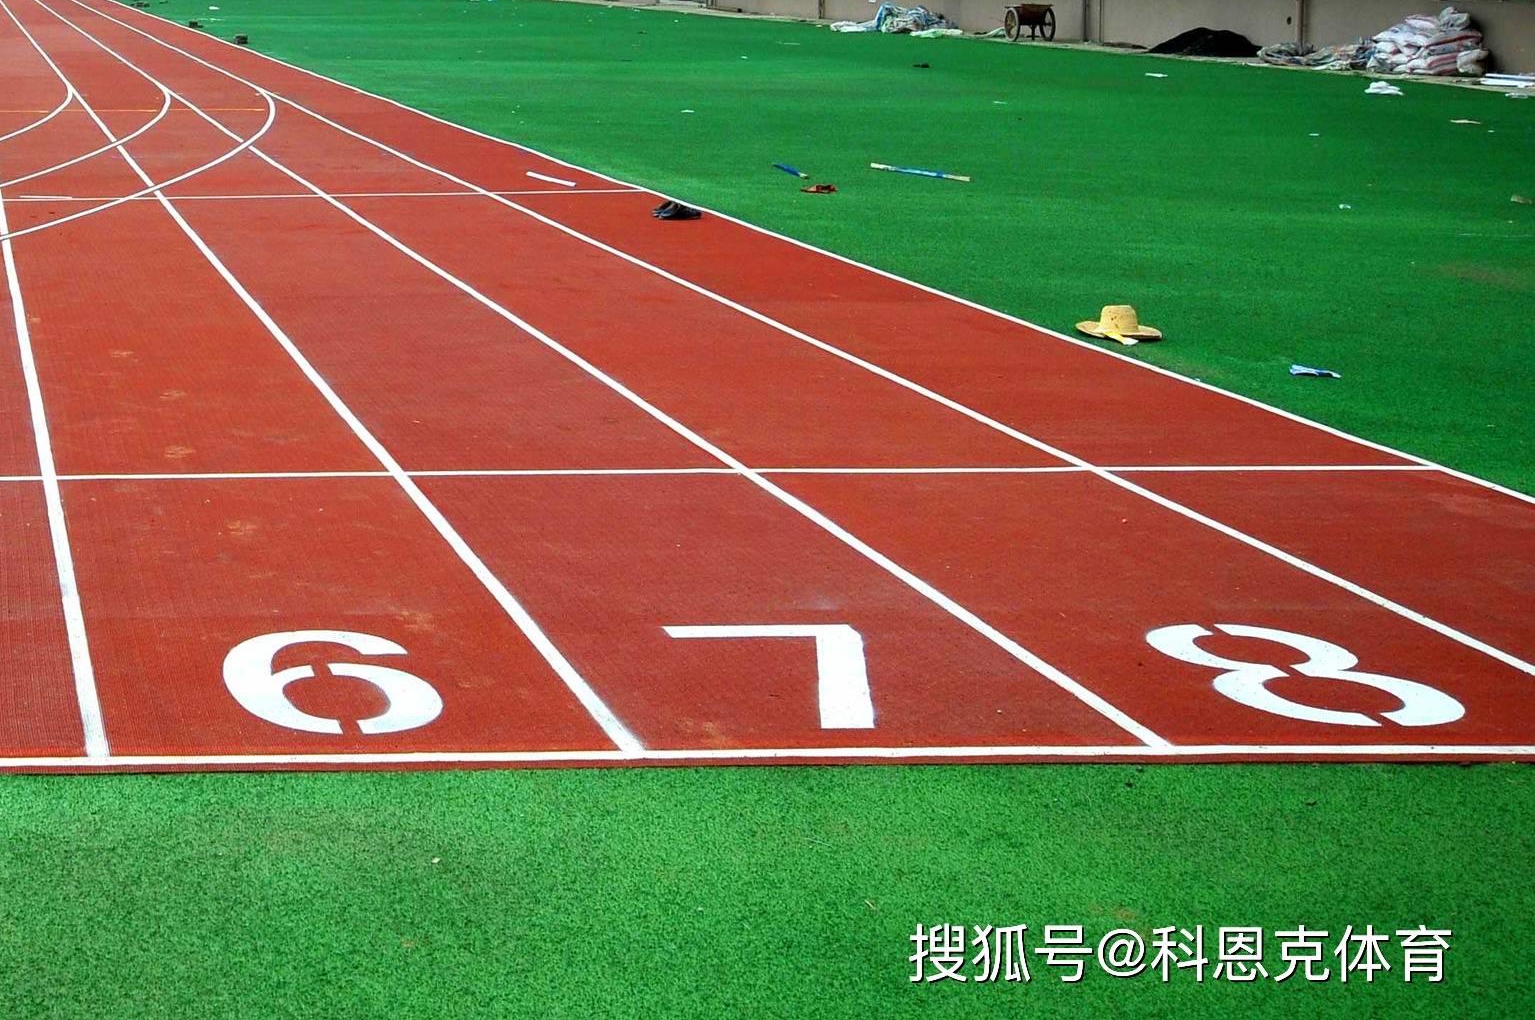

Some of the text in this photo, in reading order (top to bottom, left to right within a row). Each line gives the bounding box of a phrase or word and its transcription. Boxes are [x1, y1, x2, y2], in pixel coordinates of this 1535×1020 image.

[223, 630, 443, 735] 6
[662, 623, 875, 730] 7
[1146, 623, 1465, 727] 8
